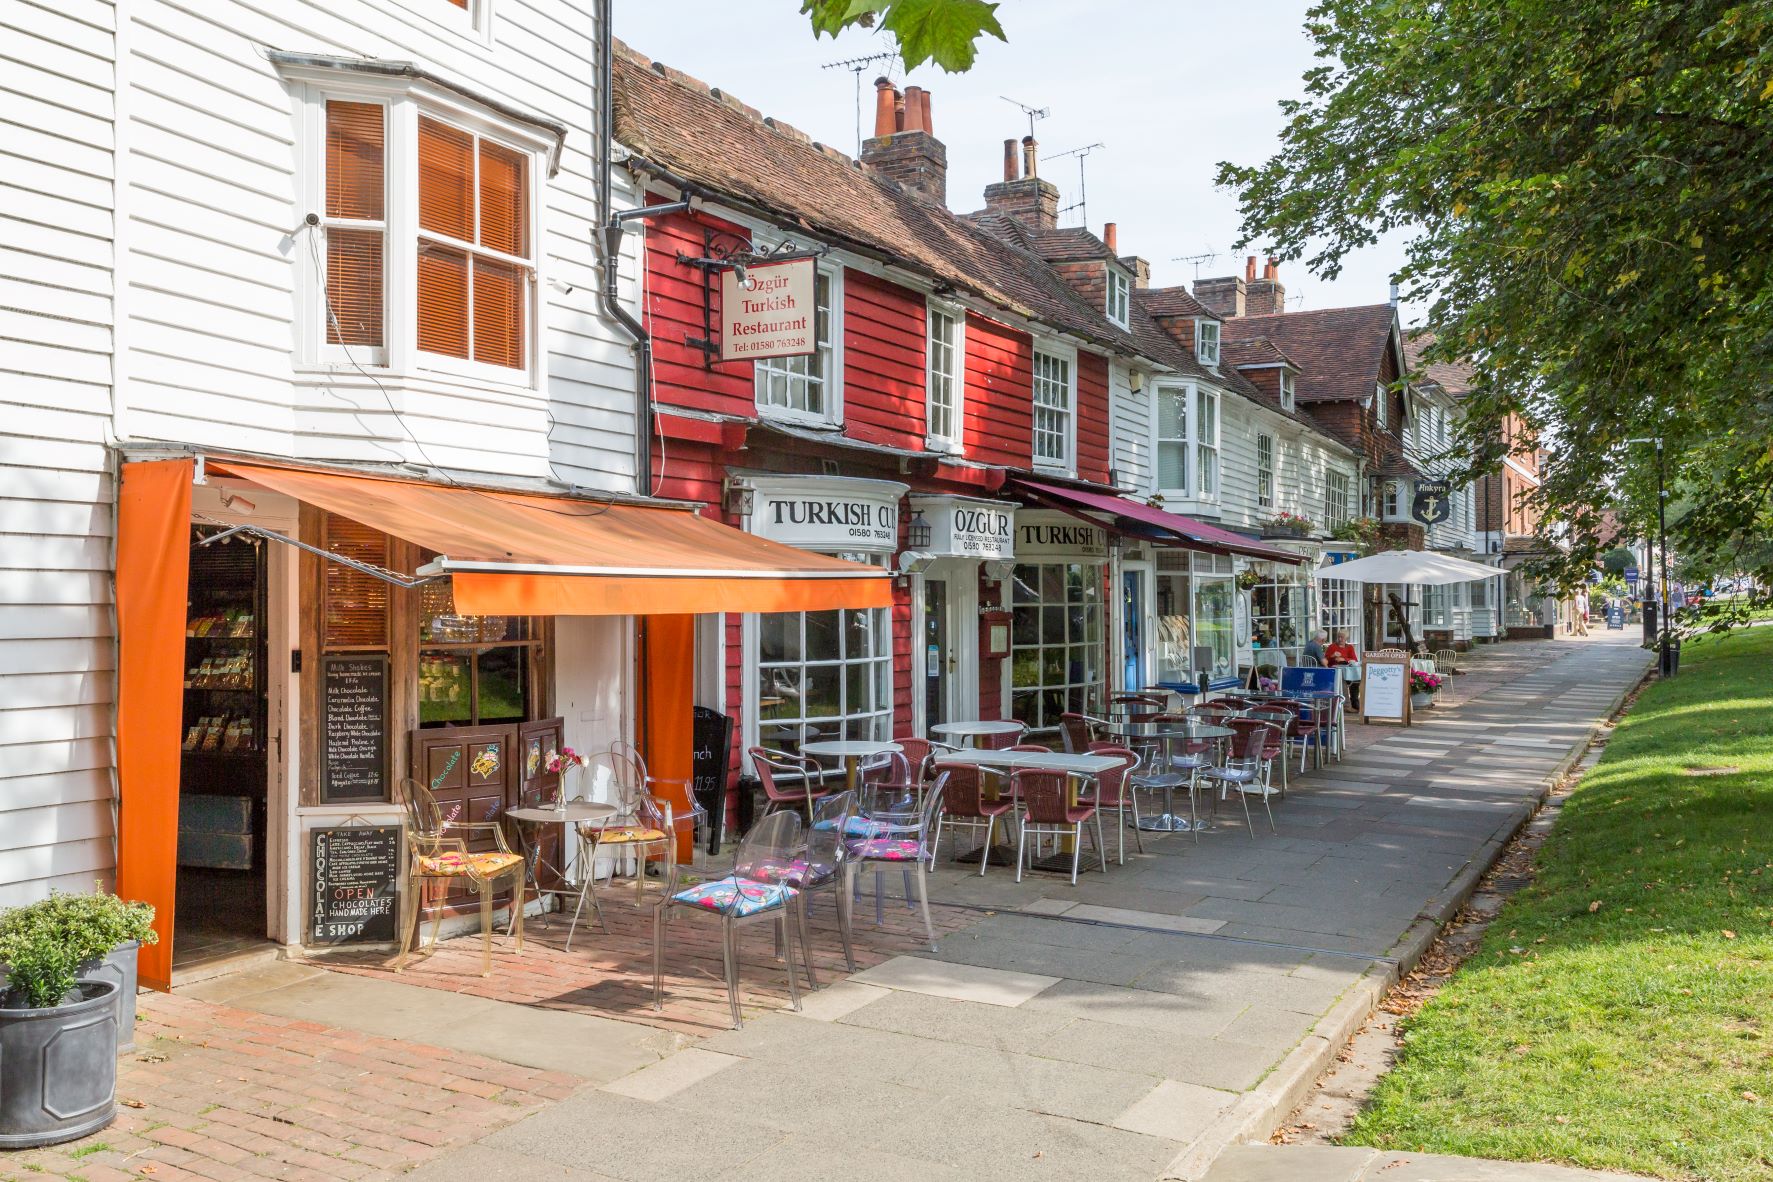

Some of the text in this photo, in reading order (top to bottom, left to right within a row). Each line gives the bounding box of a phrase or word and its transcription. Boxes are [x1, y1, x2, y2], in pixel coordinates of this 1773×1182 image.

[742, 295, 795, 313] Turkish
[732, 316, 806, 336] Restaurant
[733, 338, 806, 352] Tel: 01580 763248
[768, 500, 871, 526] TURKISH
[849, 528, 870, 537] 01580
[1020, 525, 1093, 545] TURKISH
[355, 704, 373, 713] Coffee
[431, 751, 460, 789] Chocolate
[315, 834, 326, 936] CHOCOLATE
[334, 888, 374, 899] OPEN
[332, 899, 392, 909] CHOCOLATES
[370, 907, 390, 915] HERE
[330, 924, 364, 936] SHOP
